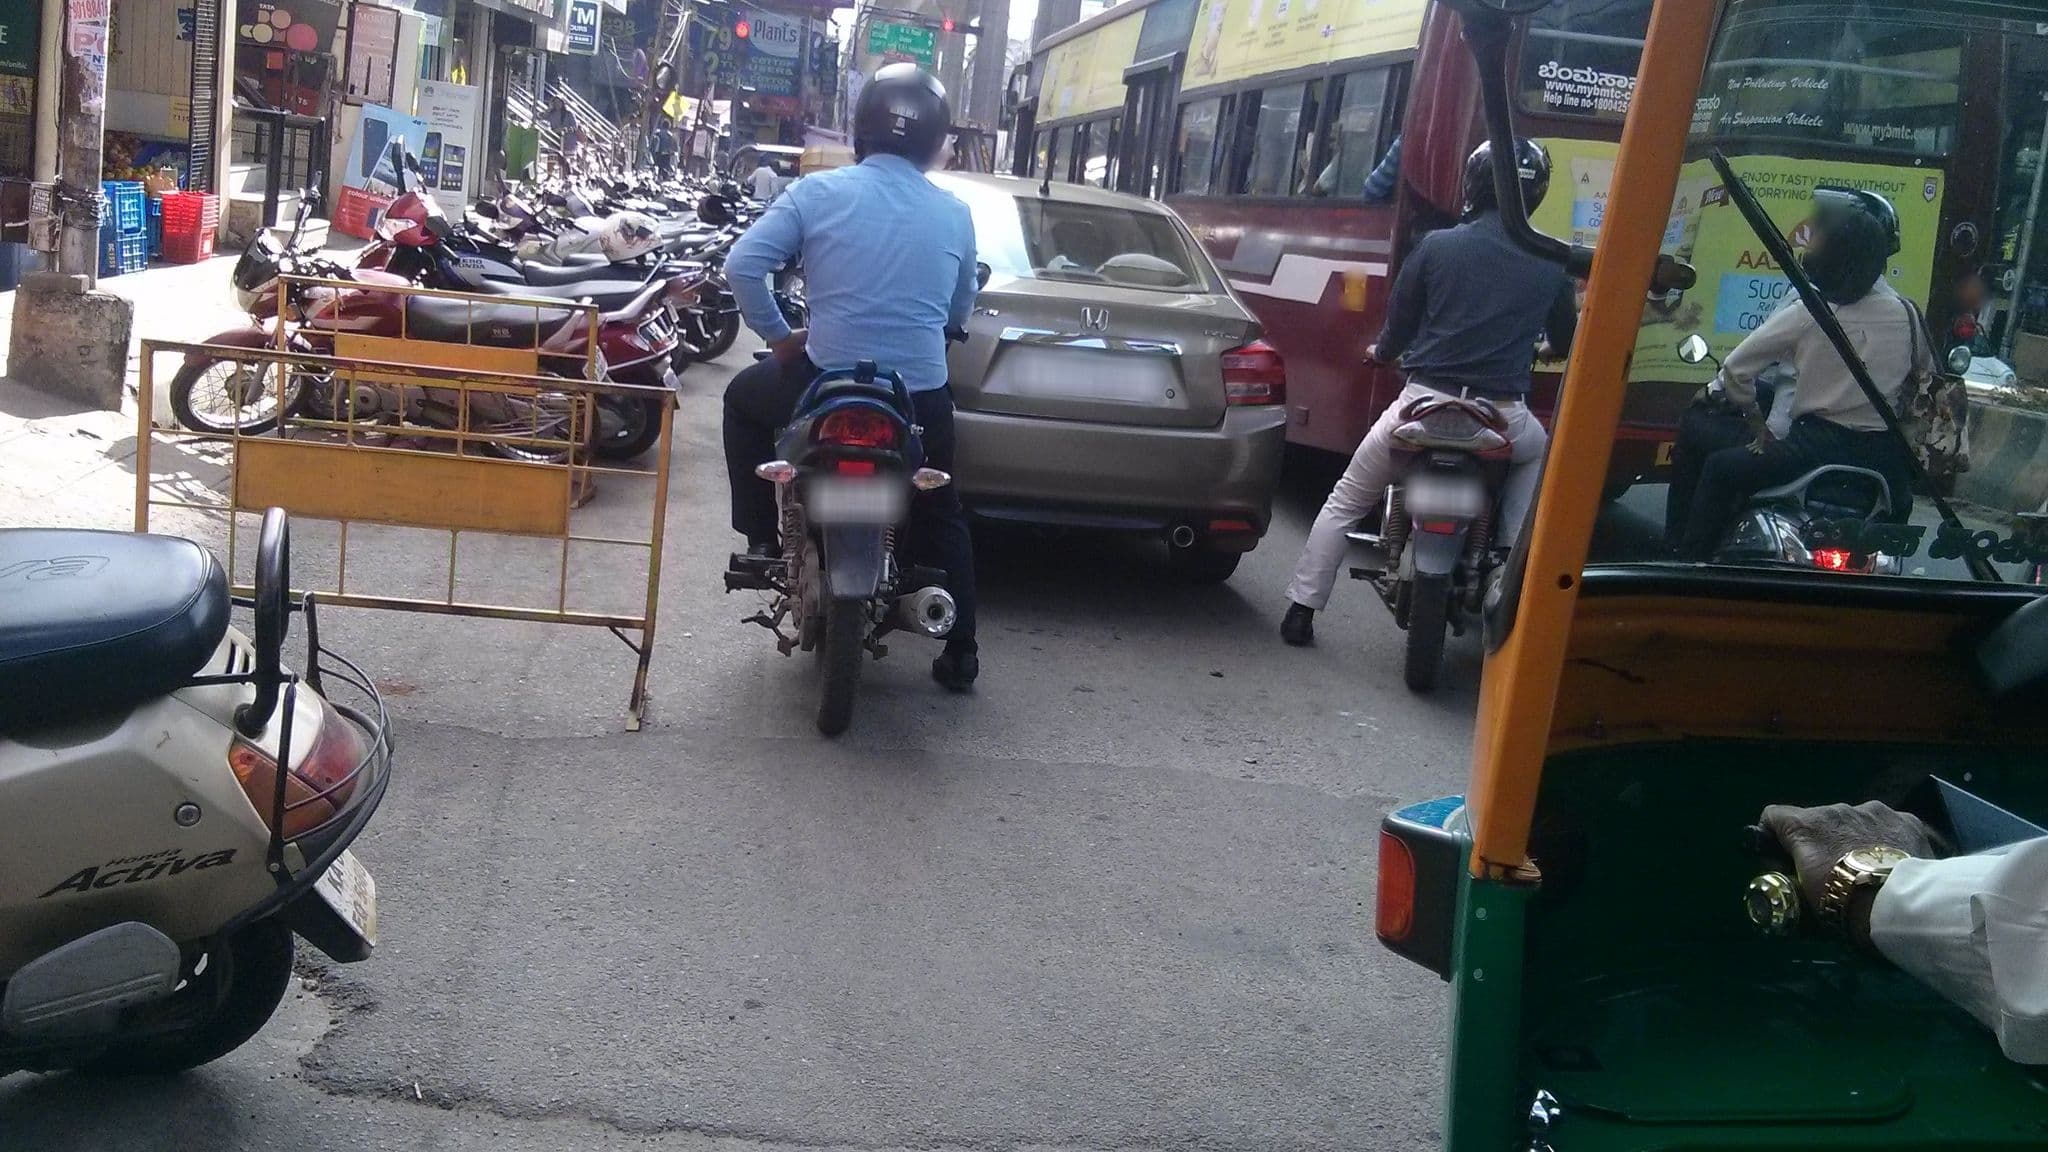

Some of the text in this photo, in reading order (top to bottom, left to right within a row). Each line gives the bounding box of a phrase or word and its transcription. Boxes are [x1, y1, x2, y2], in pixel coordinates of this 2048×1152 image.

[573, 7, 595, 25] M
[1743, 77, 1787, 91] Polluting
[1790, 77, 1829, 90] Vehicle
[1543, 91, 1562, 107] Help
[1564, 94, 1579, 106] line
[1732, 113, 1783, 126] Suspension
[1786, 113, 1824, 127] Vehicle
[1742, 171, 1778, 184] ENJOY
[1781, 173, 1816, 186] TASTY
[1854, 178, 1906, 192] WITHOUT
[1736, 250, 1781, 270] AA
[105, 848, 183, 867] Honda
[36, 847, 238, 899] Activa
